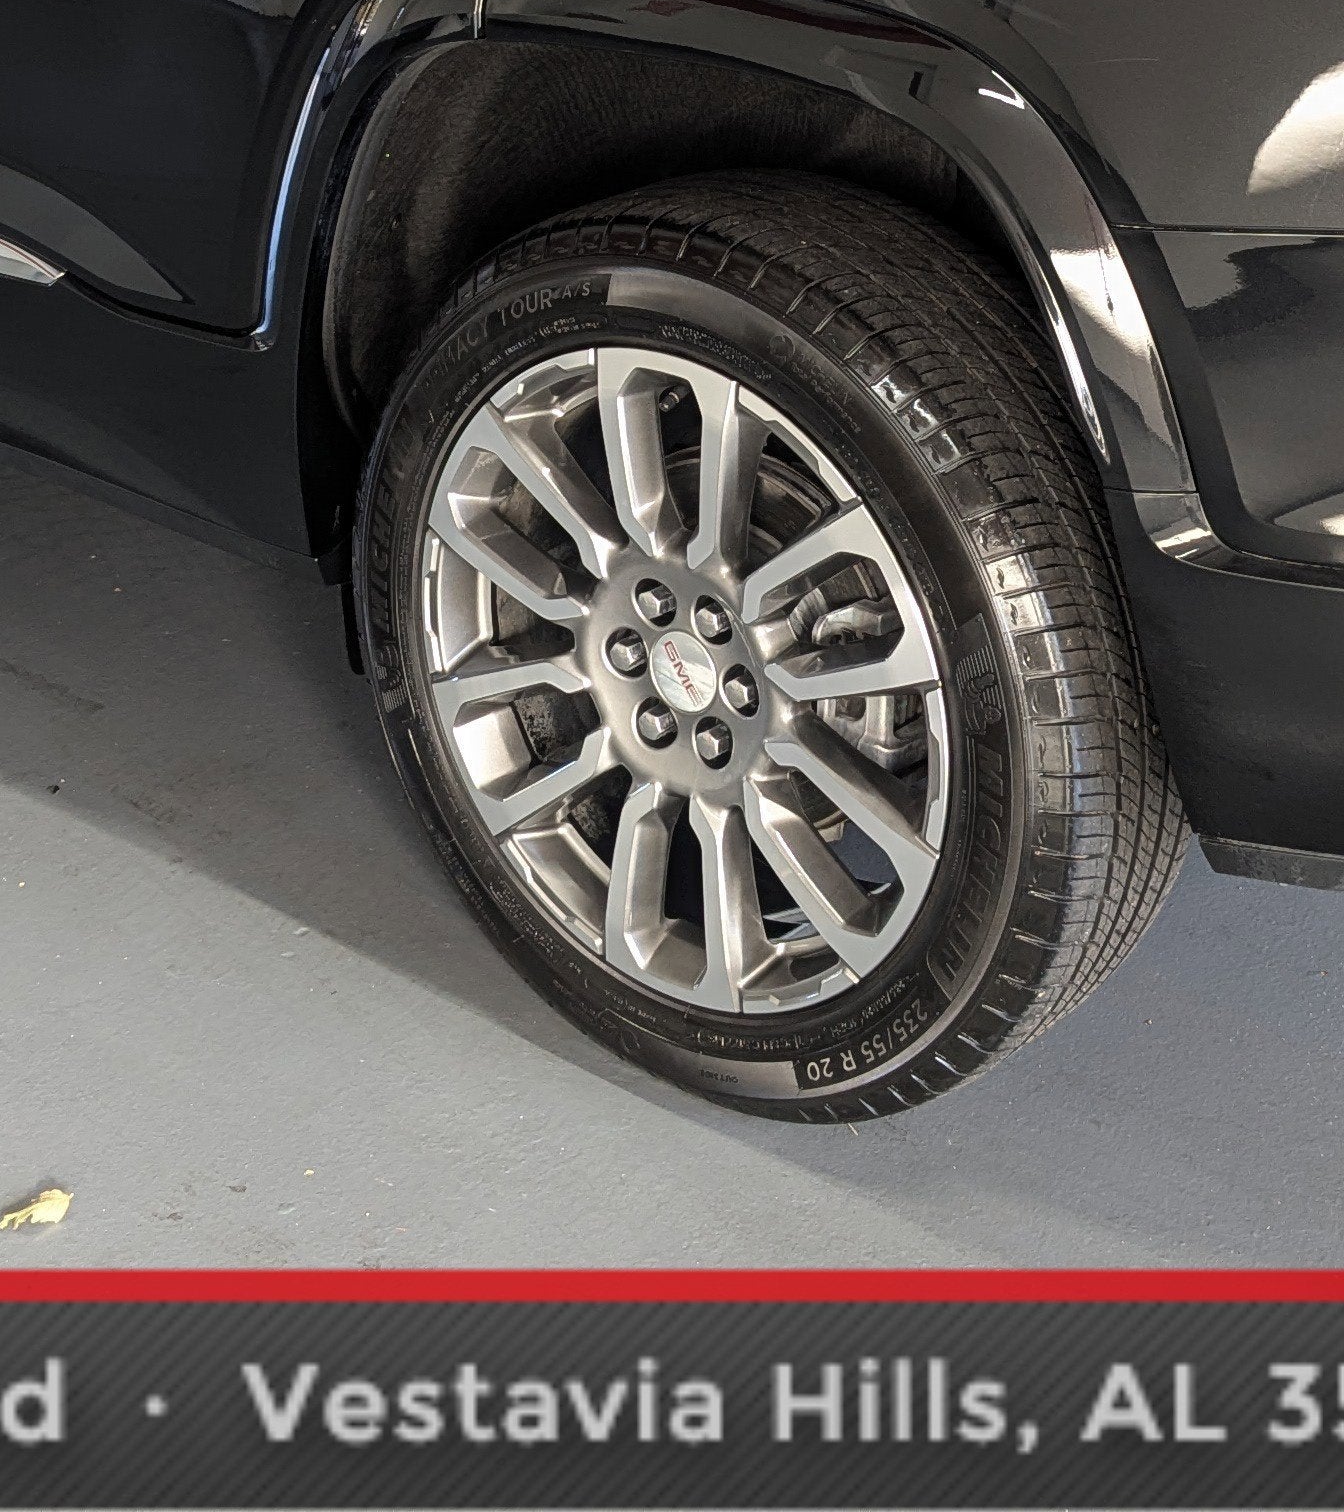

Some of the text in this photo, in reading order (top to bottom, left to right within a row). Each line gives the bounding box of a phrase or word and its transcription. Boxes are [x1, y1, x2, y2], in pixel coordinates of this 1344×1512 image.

[496, 287, 553, 328] TOUR
[561, 281, 593, 300] A/S
[662, 640, 704, 707] GMC
[861, 998, 929, 1063] 235/55
[805, 1058, 835, 1082] 20
[839, 1046, 858, 1073] R
